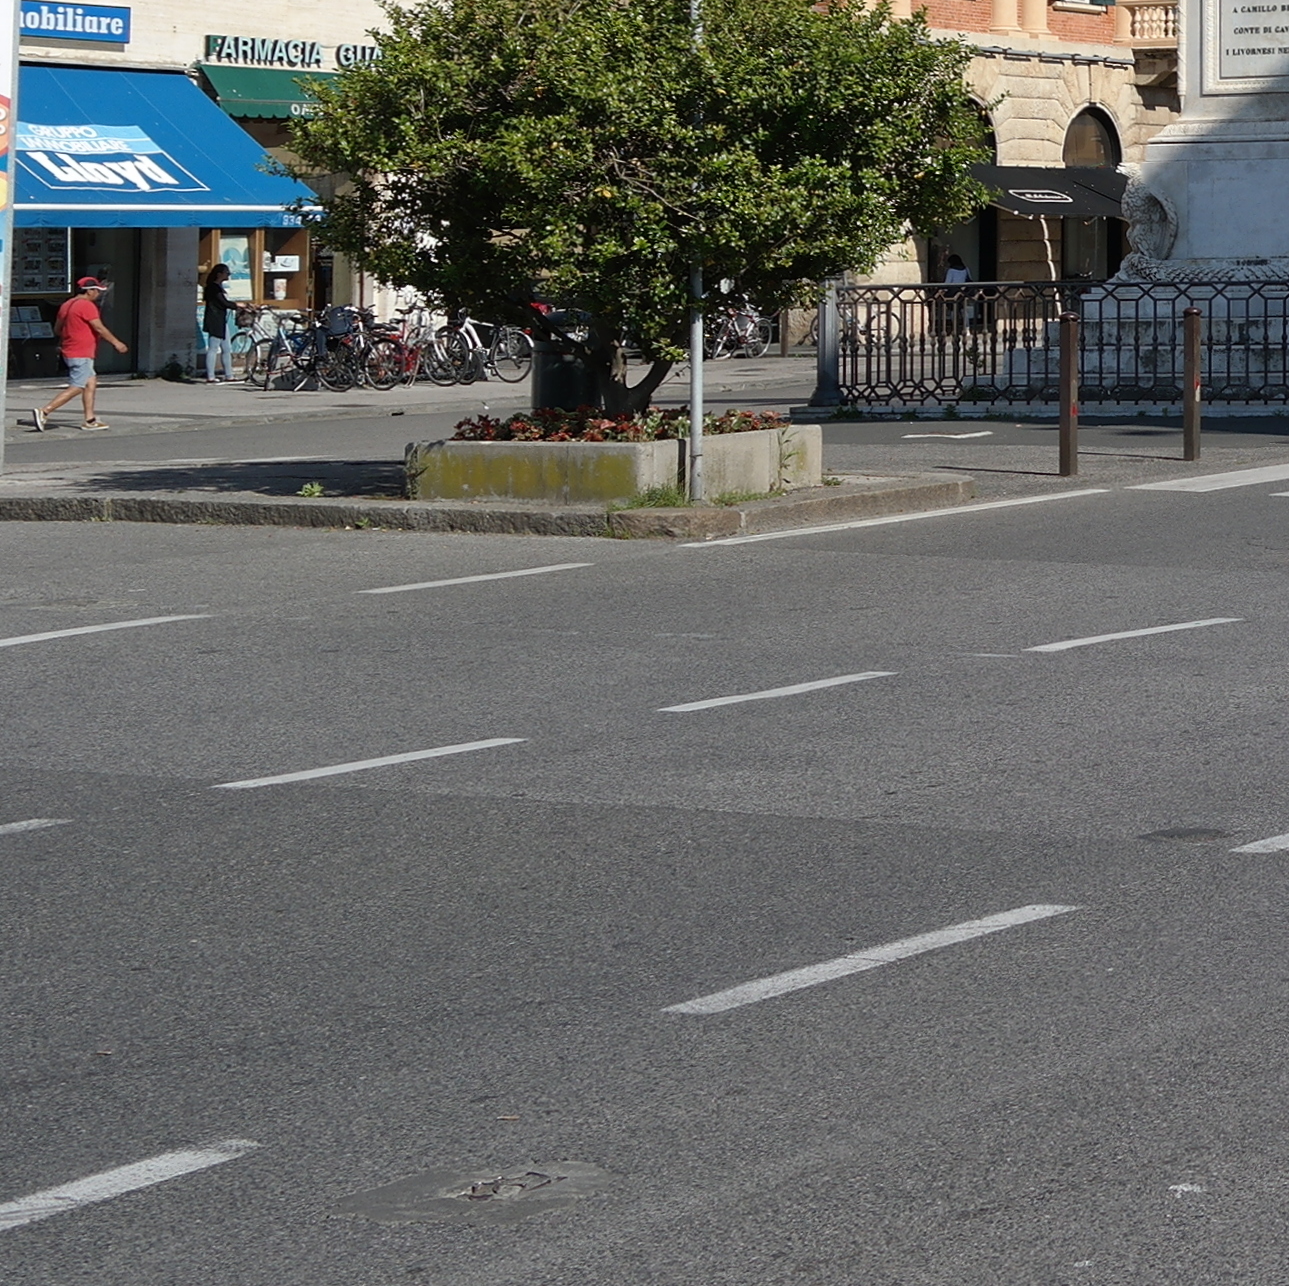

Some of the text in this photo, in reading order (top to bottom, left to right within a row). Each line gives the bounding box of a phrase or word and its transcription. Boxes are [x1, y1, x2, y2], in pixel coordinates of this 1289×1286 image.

[1241, 5, 1278, 13] CAMILLO
[1234, 27, 1260, 35] CONTE
[205, 35, 323, 64] FARMACIA
[1232, 47, 1275, 56] LIVORNESI
[28, 125, 97, 138] GRUPPO
[21, 137, 132, 152] IMMOBILIARE
[26, 152, 179, 192] Lloyd
